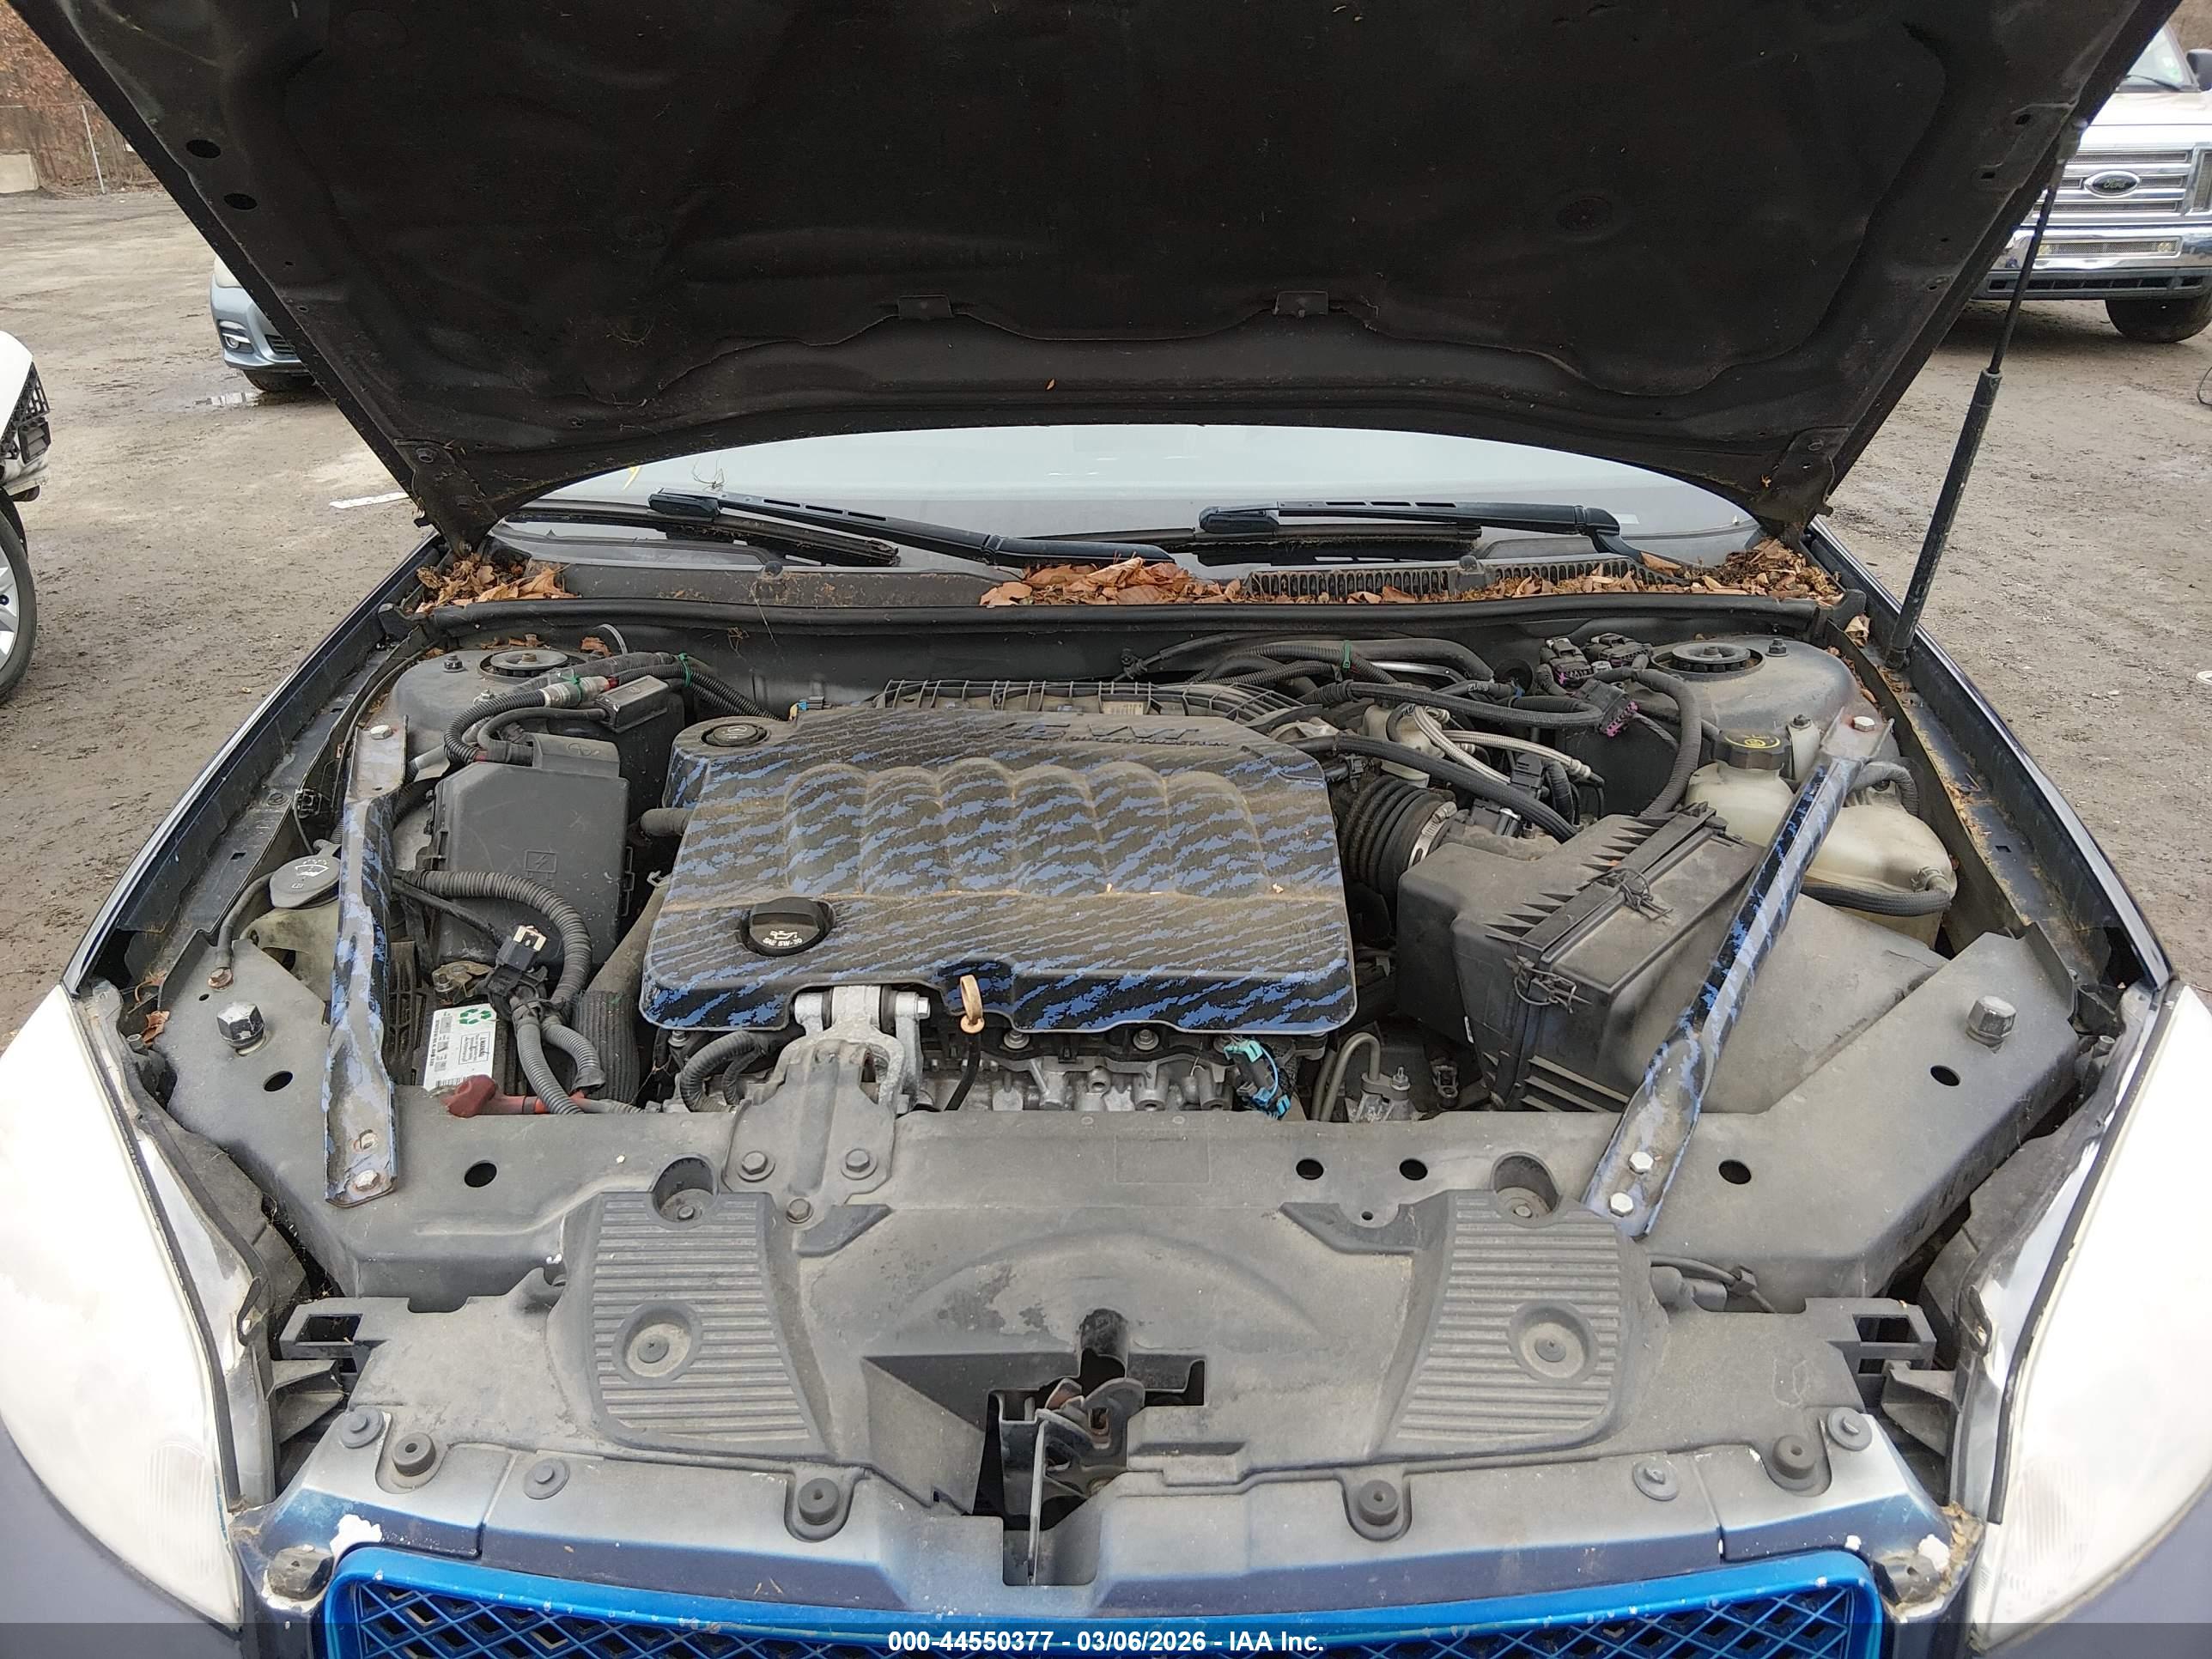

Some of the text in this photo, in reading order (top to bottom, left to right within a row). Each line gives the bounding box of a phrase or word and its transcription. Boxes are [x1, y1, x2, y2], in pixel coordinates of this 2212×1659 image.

[2104, 178, 2127, 188] Ford
[763, 938, 803, 947] SAE 5W-30
